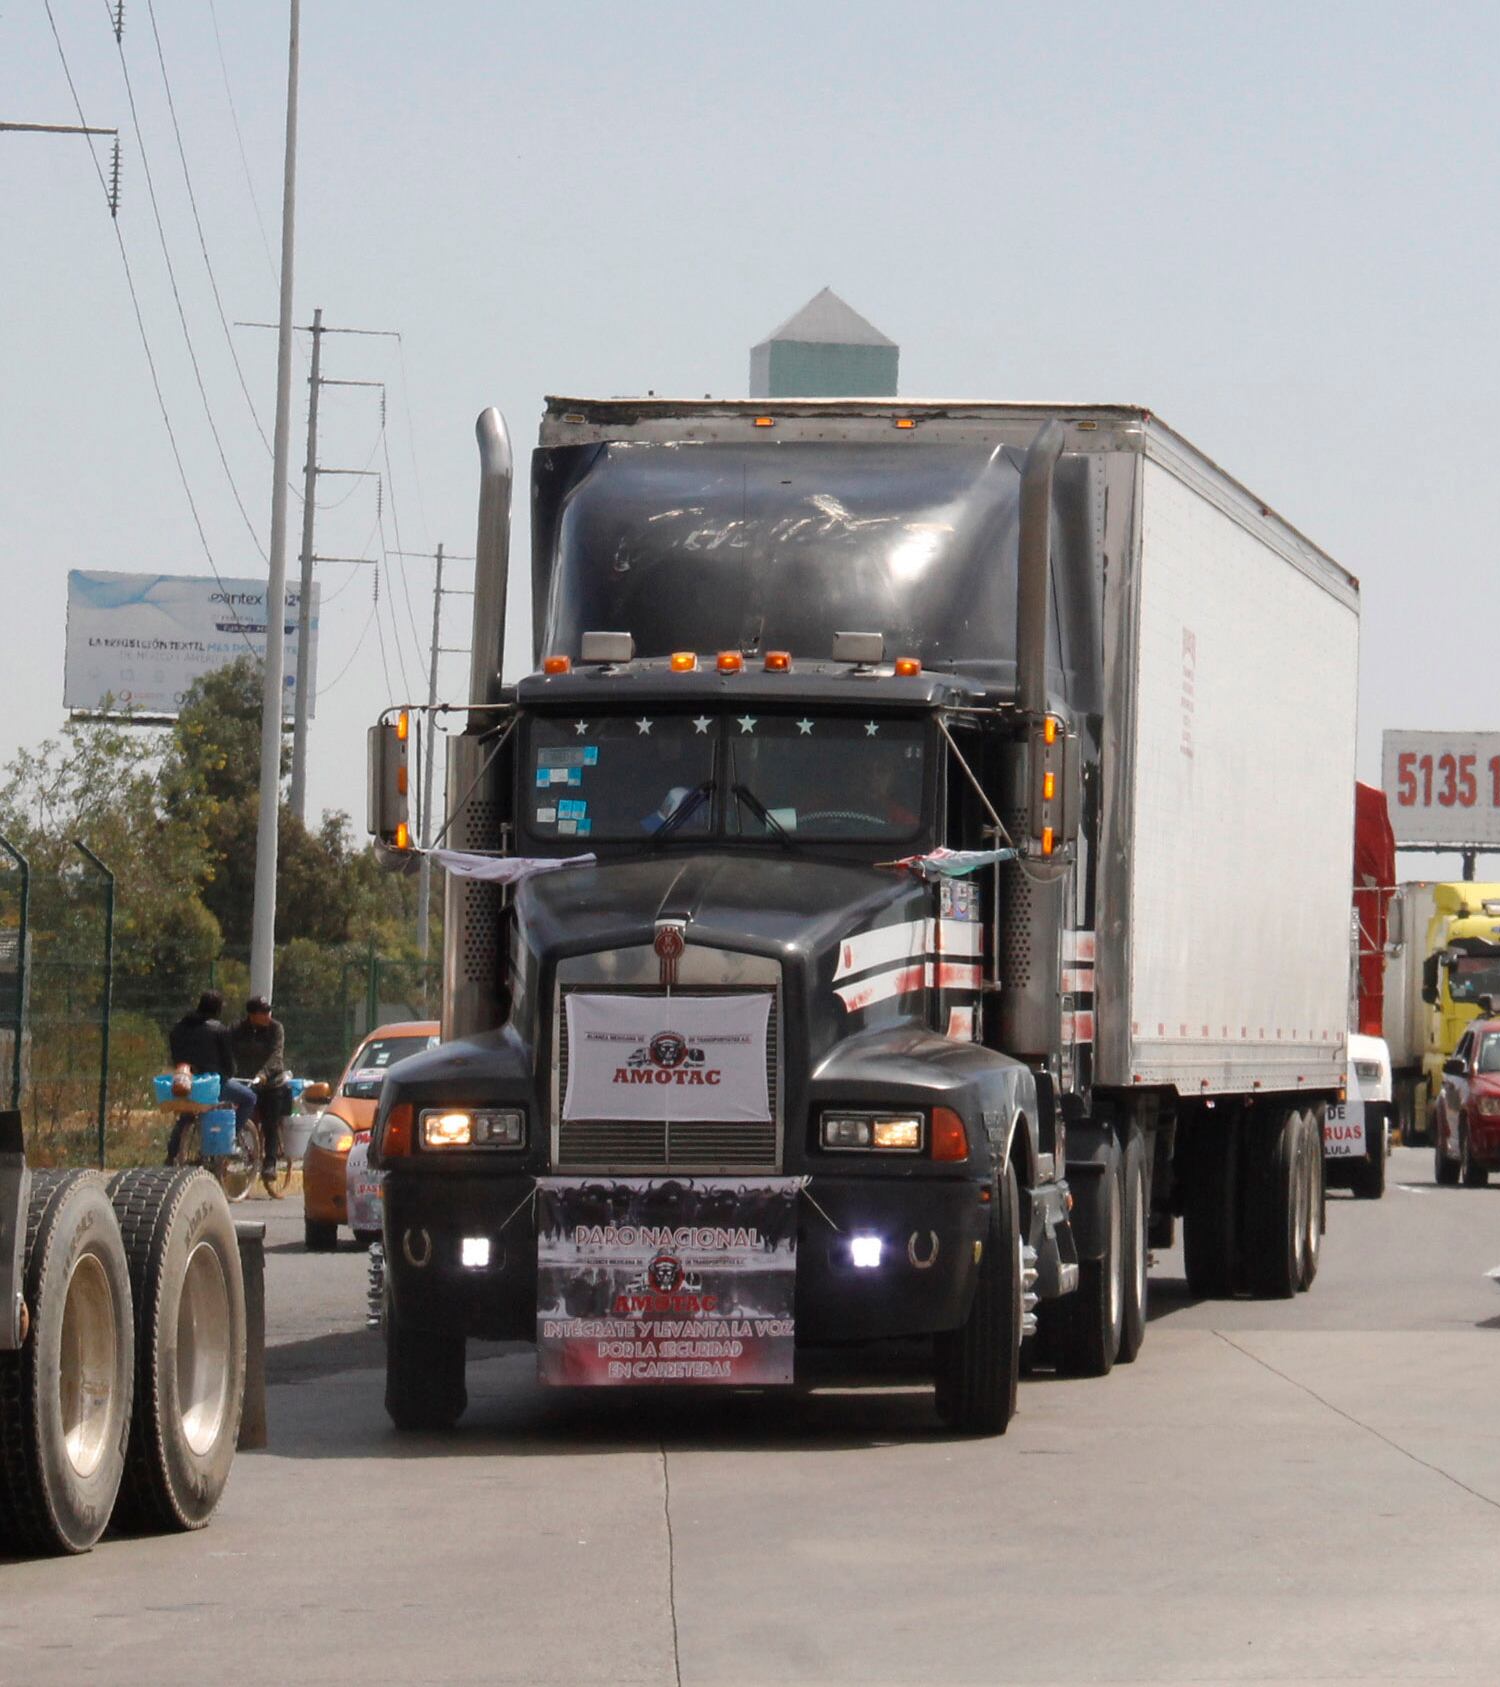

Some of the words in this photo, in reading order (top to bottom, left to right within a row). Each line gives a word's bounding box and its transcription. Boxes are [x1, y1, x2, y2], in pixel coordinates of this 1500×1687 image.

[1398, 752, 1477, 808] 5135
[613, 1068, 721, 1085] AMOTAC
[1327, 1106, 1346, 1120] DE
[575, 1225, 636, 1247] PARO
[640, 1227, 760, 1249] NACIONAL
[613, 1295, 718, 1313] AMOTAC
[636, 1321, 652, 1338] Y
[752, 1320, 795, 1337] VOZ
[598, 1341, 634, 1358] POR
[635, 1342, 656, 1358] LA
[658, 1341, 743, 1358] SEGURIDAD
[608, 1362, 632, 1378] EN
[632, 1360, 731, 1378] CARRETERAS
